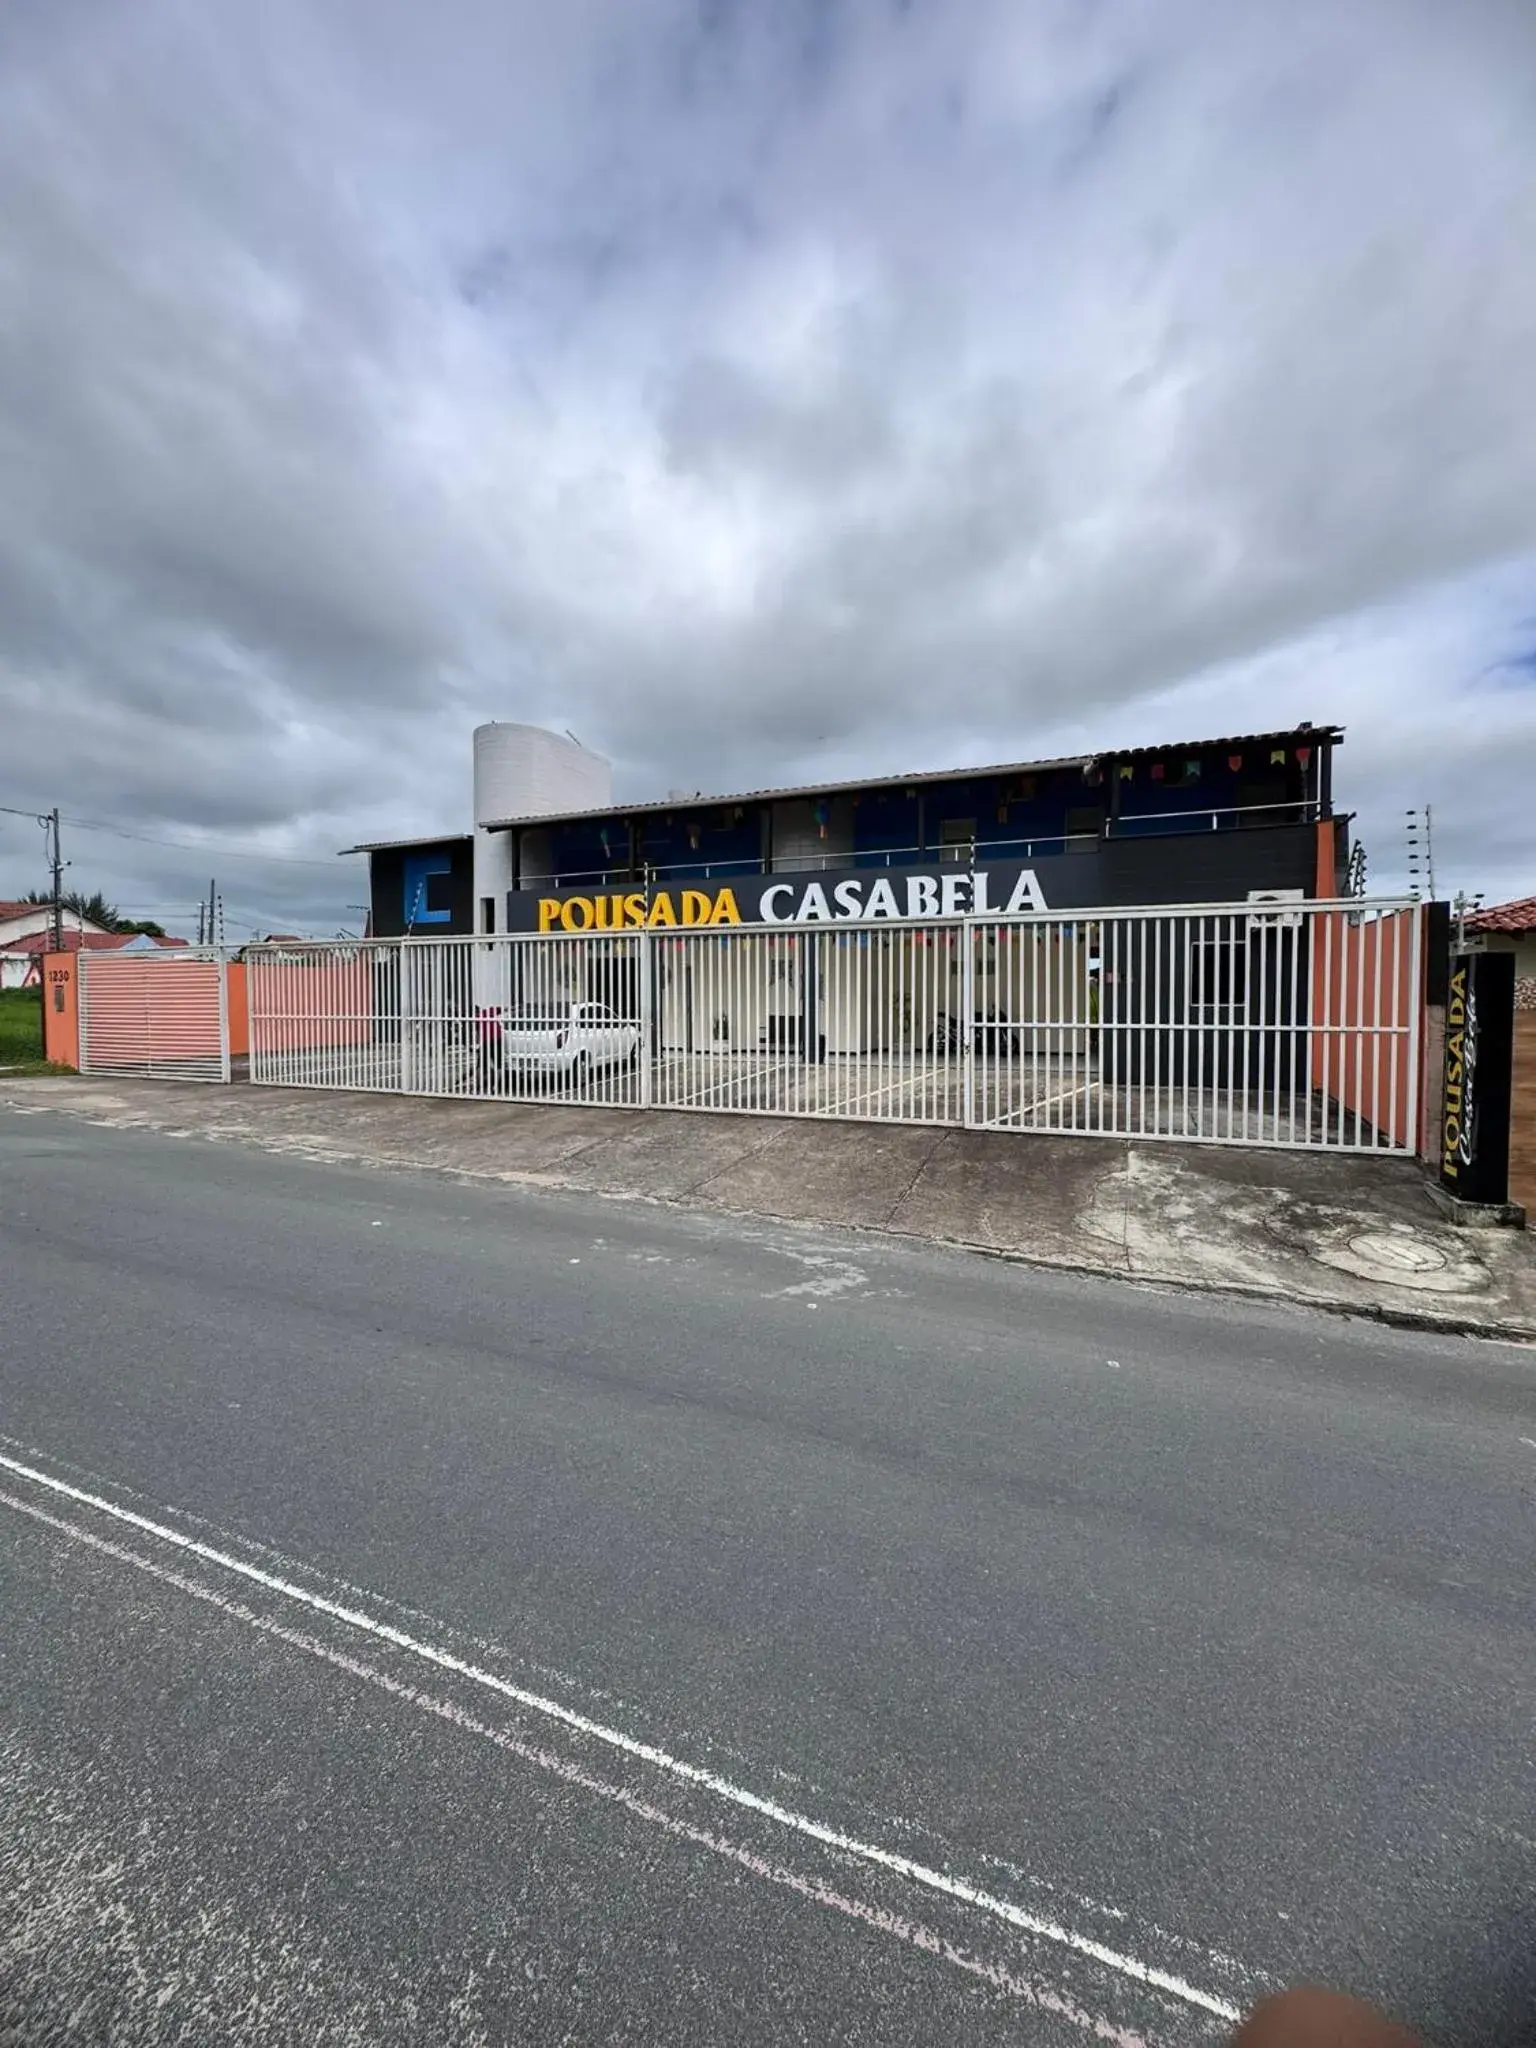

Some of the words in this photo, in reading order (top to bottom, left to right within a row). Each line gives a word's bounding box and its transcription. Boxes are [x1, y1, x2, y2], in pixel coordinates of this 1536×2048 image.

[538, 888, 742, 932] POUSADA
[760, 869, 1049, 922] CASABELA
[49, 970, 70, 982] 1230
[1444, 968, 1466, 1178] POUSADA
